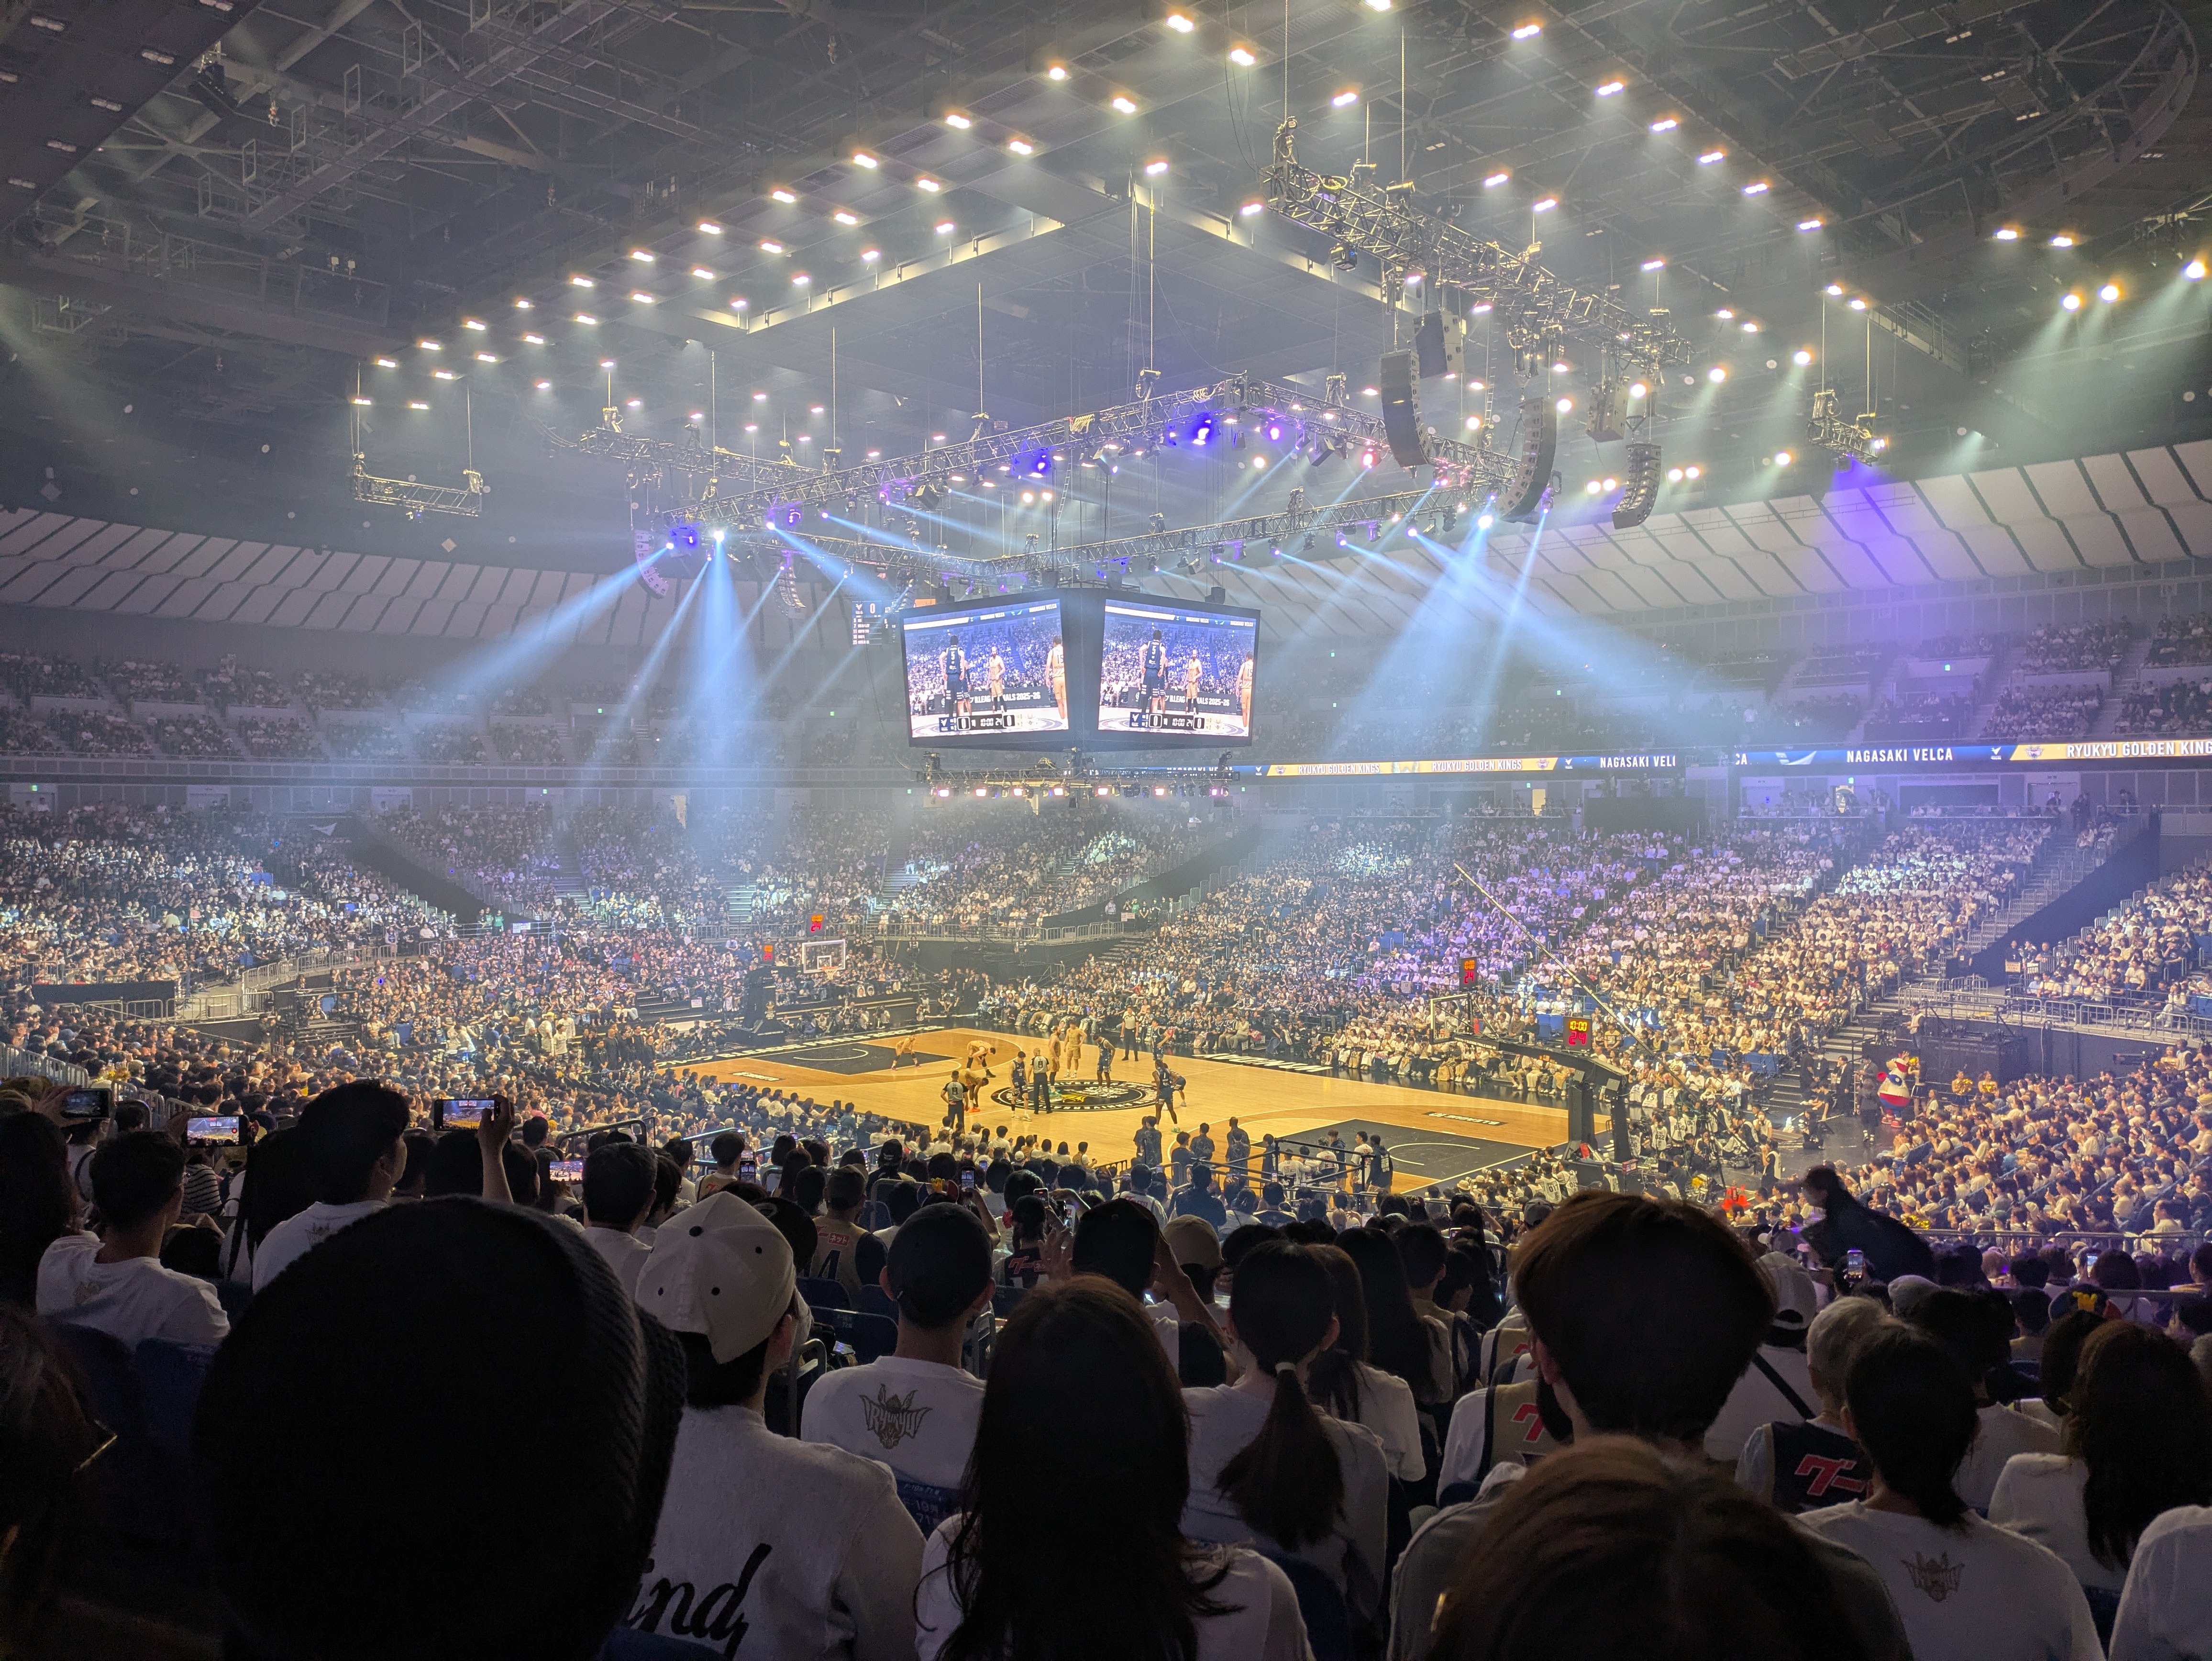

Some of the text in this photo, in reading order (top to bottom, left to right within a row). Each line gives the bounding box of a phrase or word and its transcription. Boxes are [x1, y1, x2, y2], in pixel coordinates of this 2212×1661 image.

[1016, 691, 1041, 701] 2025-26
[1208, 698, 1230, 707] 2025-26
[961, 718, 966, 729] 0
[980, 718, 994, 726] 10:00
[995, 718, 1002, 726] 24
[1007, 715, 1012, 726] 0
[1153, 715, 1159, 726] 0
[1172, 718, 1185, 727] 10:00
[1186, 719, 1193, 727] 24
[1197, 718, 1202, 729] 0
[1847, 747, 1953, 763] NAGASAKI VELCA
[2067, 743, 2117, 758] RYUKYU
[2122, 742, 2175, 756] GOLDEN
[1432, 759, 1522, 771] RYUKYU GOLDEN KINGS
[1600, 756, 1649, 768] NAGASAKI
[1298, 763, 1380, 775] RYUKYU GOLDEN KINGS
[811, 923, 821, 932] 24
[1464, 971, 1474, 984] 24
[1570, 1020, 1588, 1031] 10:00
[803, 1035, 871, 1047] FINALS
[1569, 1031, 1587, 1045] 24
